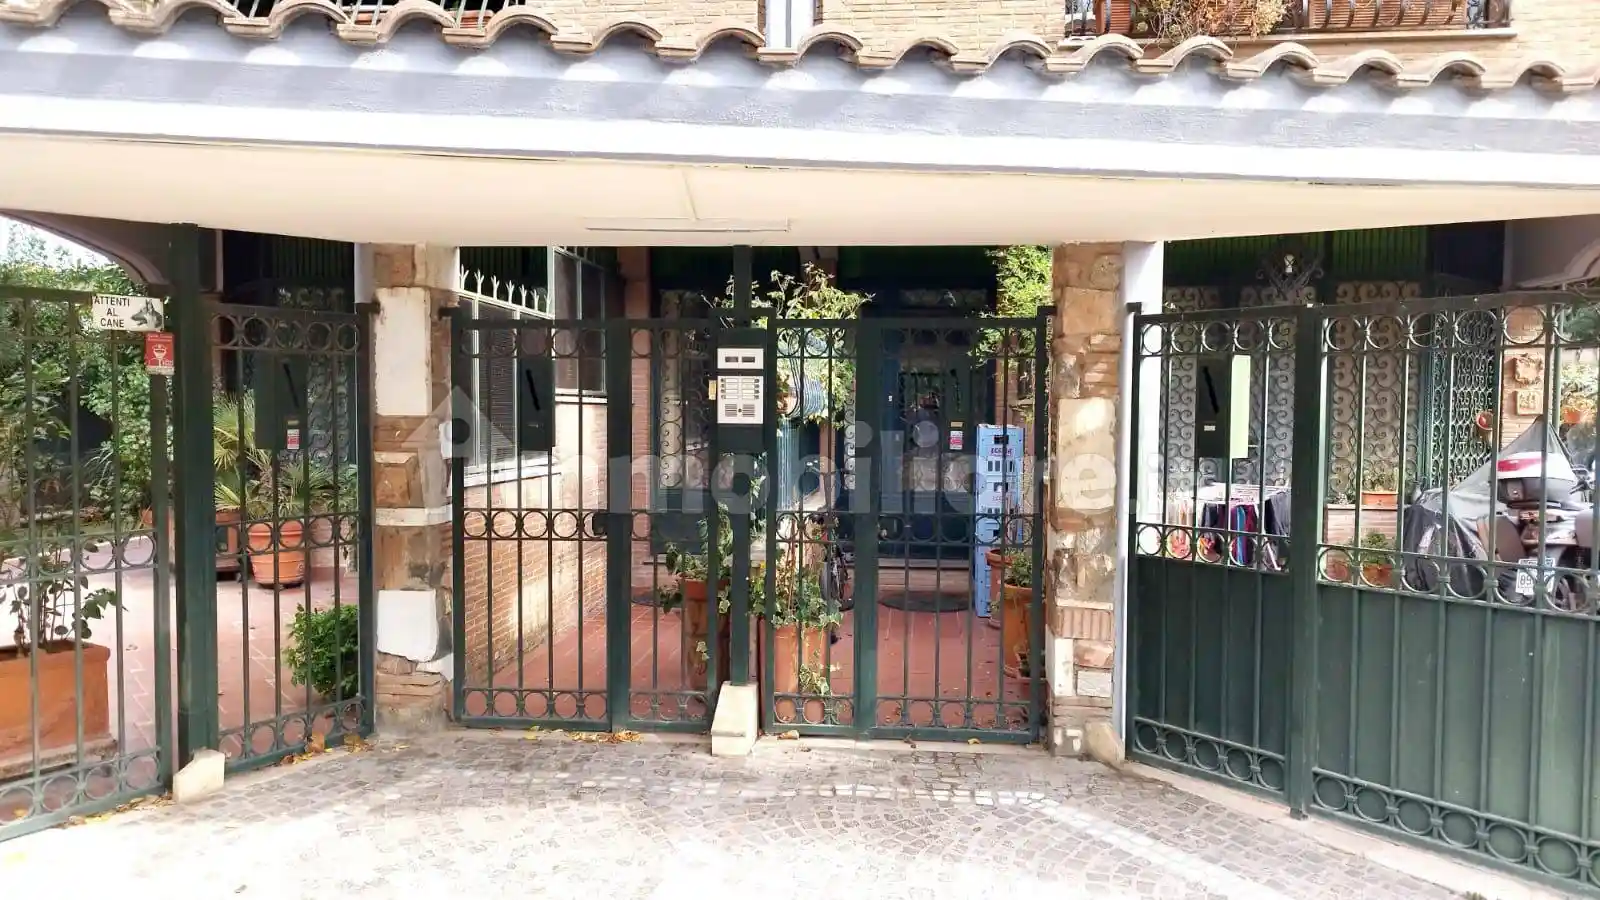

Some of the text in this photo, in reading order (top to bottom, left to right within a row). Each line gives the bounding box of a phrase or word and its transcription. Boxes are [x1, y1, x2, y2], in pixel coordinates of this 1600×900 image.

[94, 296, 130, 307] ATTENTI
[107, 307, 118, 317] AL
[100, 317, 125, 328] CANE
